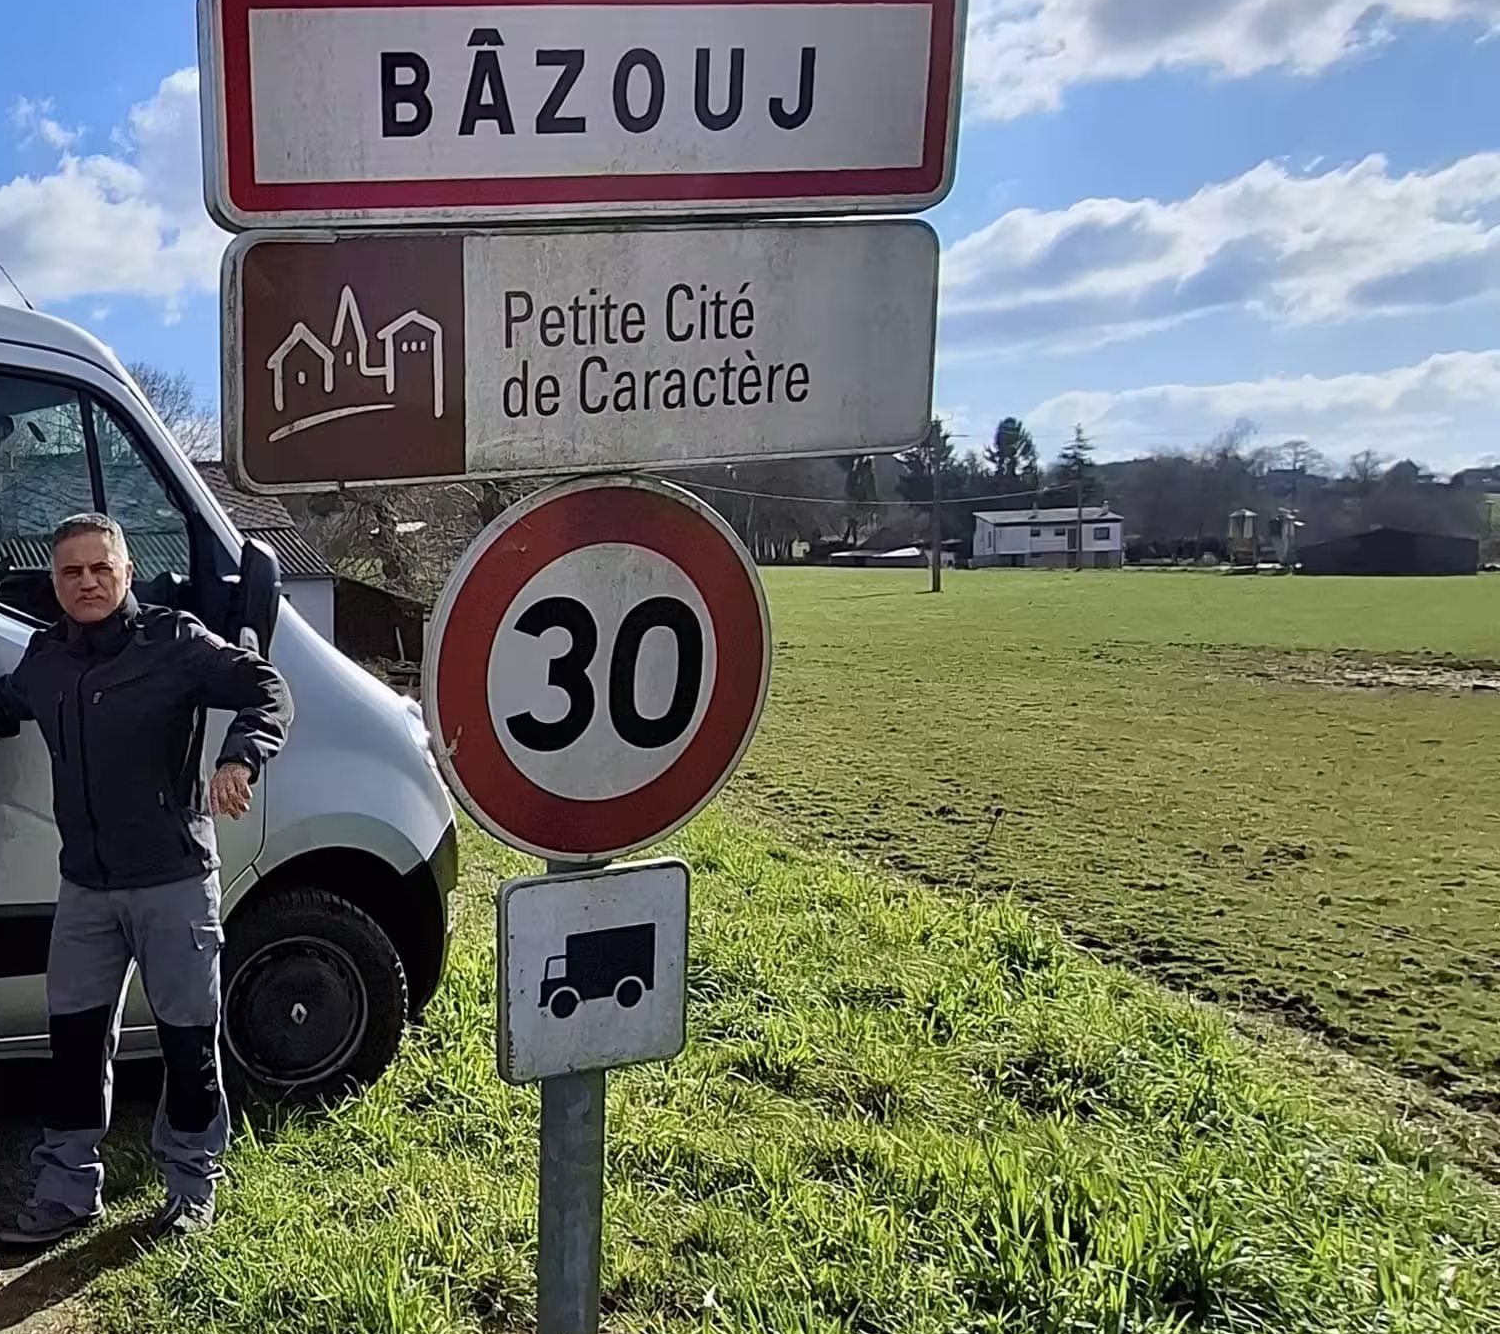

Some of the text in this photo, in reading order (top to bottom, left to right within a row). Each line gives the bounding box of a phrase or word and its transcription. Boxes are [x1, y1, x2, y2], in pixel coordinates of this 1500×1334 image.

[379, 28, 816, 138] BÂZOUJ
[503, 281, 756, 350] Petite Cité
[502, 349, 810, 419] de Caractère
[505, 595, 704, 753] 30
